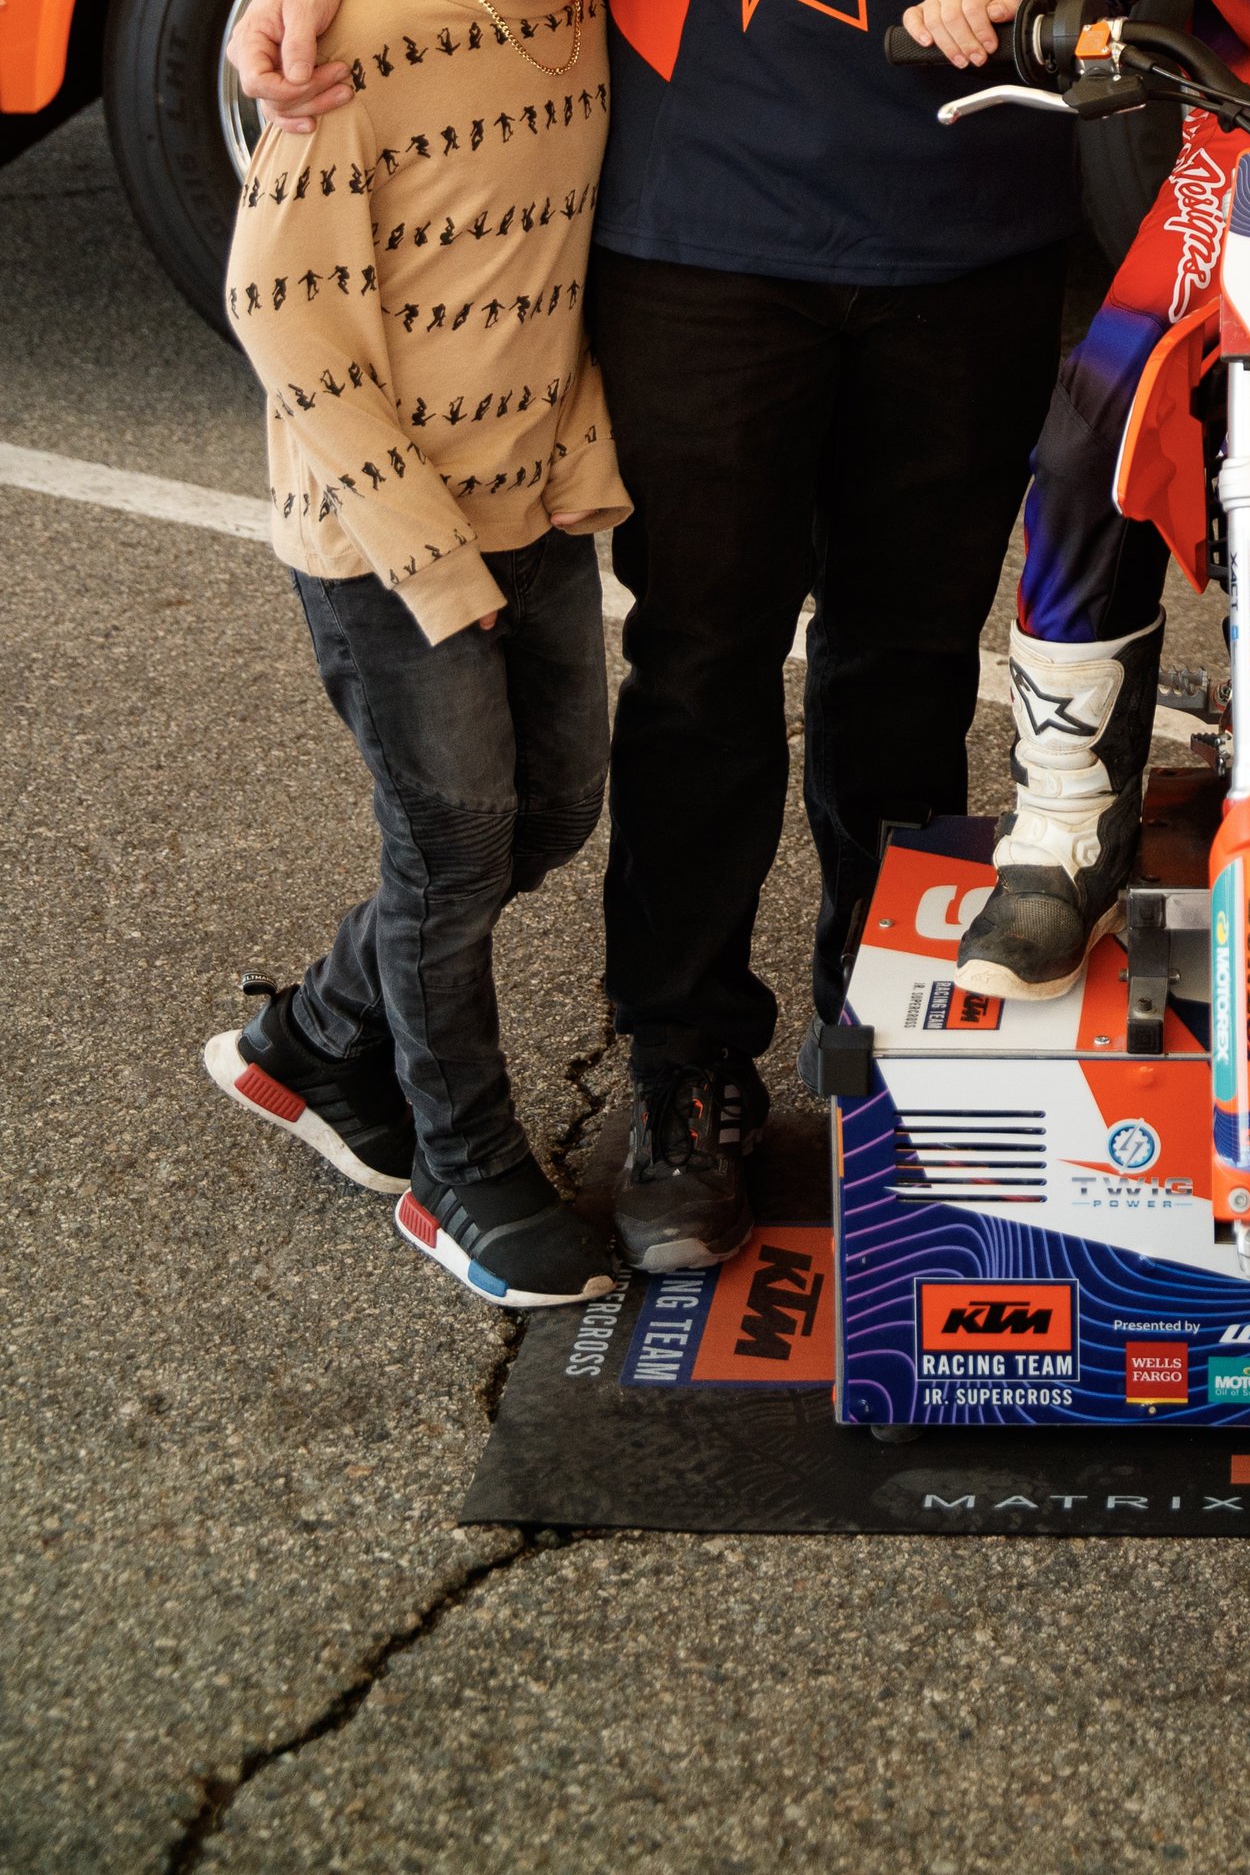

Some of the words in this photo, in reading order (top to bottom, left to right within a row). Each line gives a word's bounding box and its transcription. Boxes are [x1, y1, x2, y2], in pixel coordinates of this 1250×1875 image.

[930, 982, 952, 1009] RACING
[1214, 946, 1230, 1063] MOTOREX
[904, 992, 924, 1029] SUPERCROSS
[926, 1010, 946, 1029] TEAM
[1071, 1176, 1194, 1197] TWIG
[1092, 1200, 1172, 1208] POWER
[655, 1270, 706, 1310] ING
[734, 1244, 825, 1362] KTM
[941, 1300, 1054, 1335] KTM
[1113, 1320, 1182, 1333] Presented
[1185, 1321, 1201, 1335] by
[632, 1318, 693, 1381] TEAM
[922, 1353, 1006, 1378] RACING
[1014, 1354, 1073, 1378] TEAM
[1131, 1357, 1182, 1369] WELLS
[1132, 1371, 1183, 1383] FARGO
[922, 1386, 949, 1407] JR.
[954, 1385, 1073, 1407] SUPERCROSS
[1215, 1389, 1229, 1397] Oil
[1230, 1389, 1242, 1397] of
[923, 1494, 1243, 1512] MATRIX
